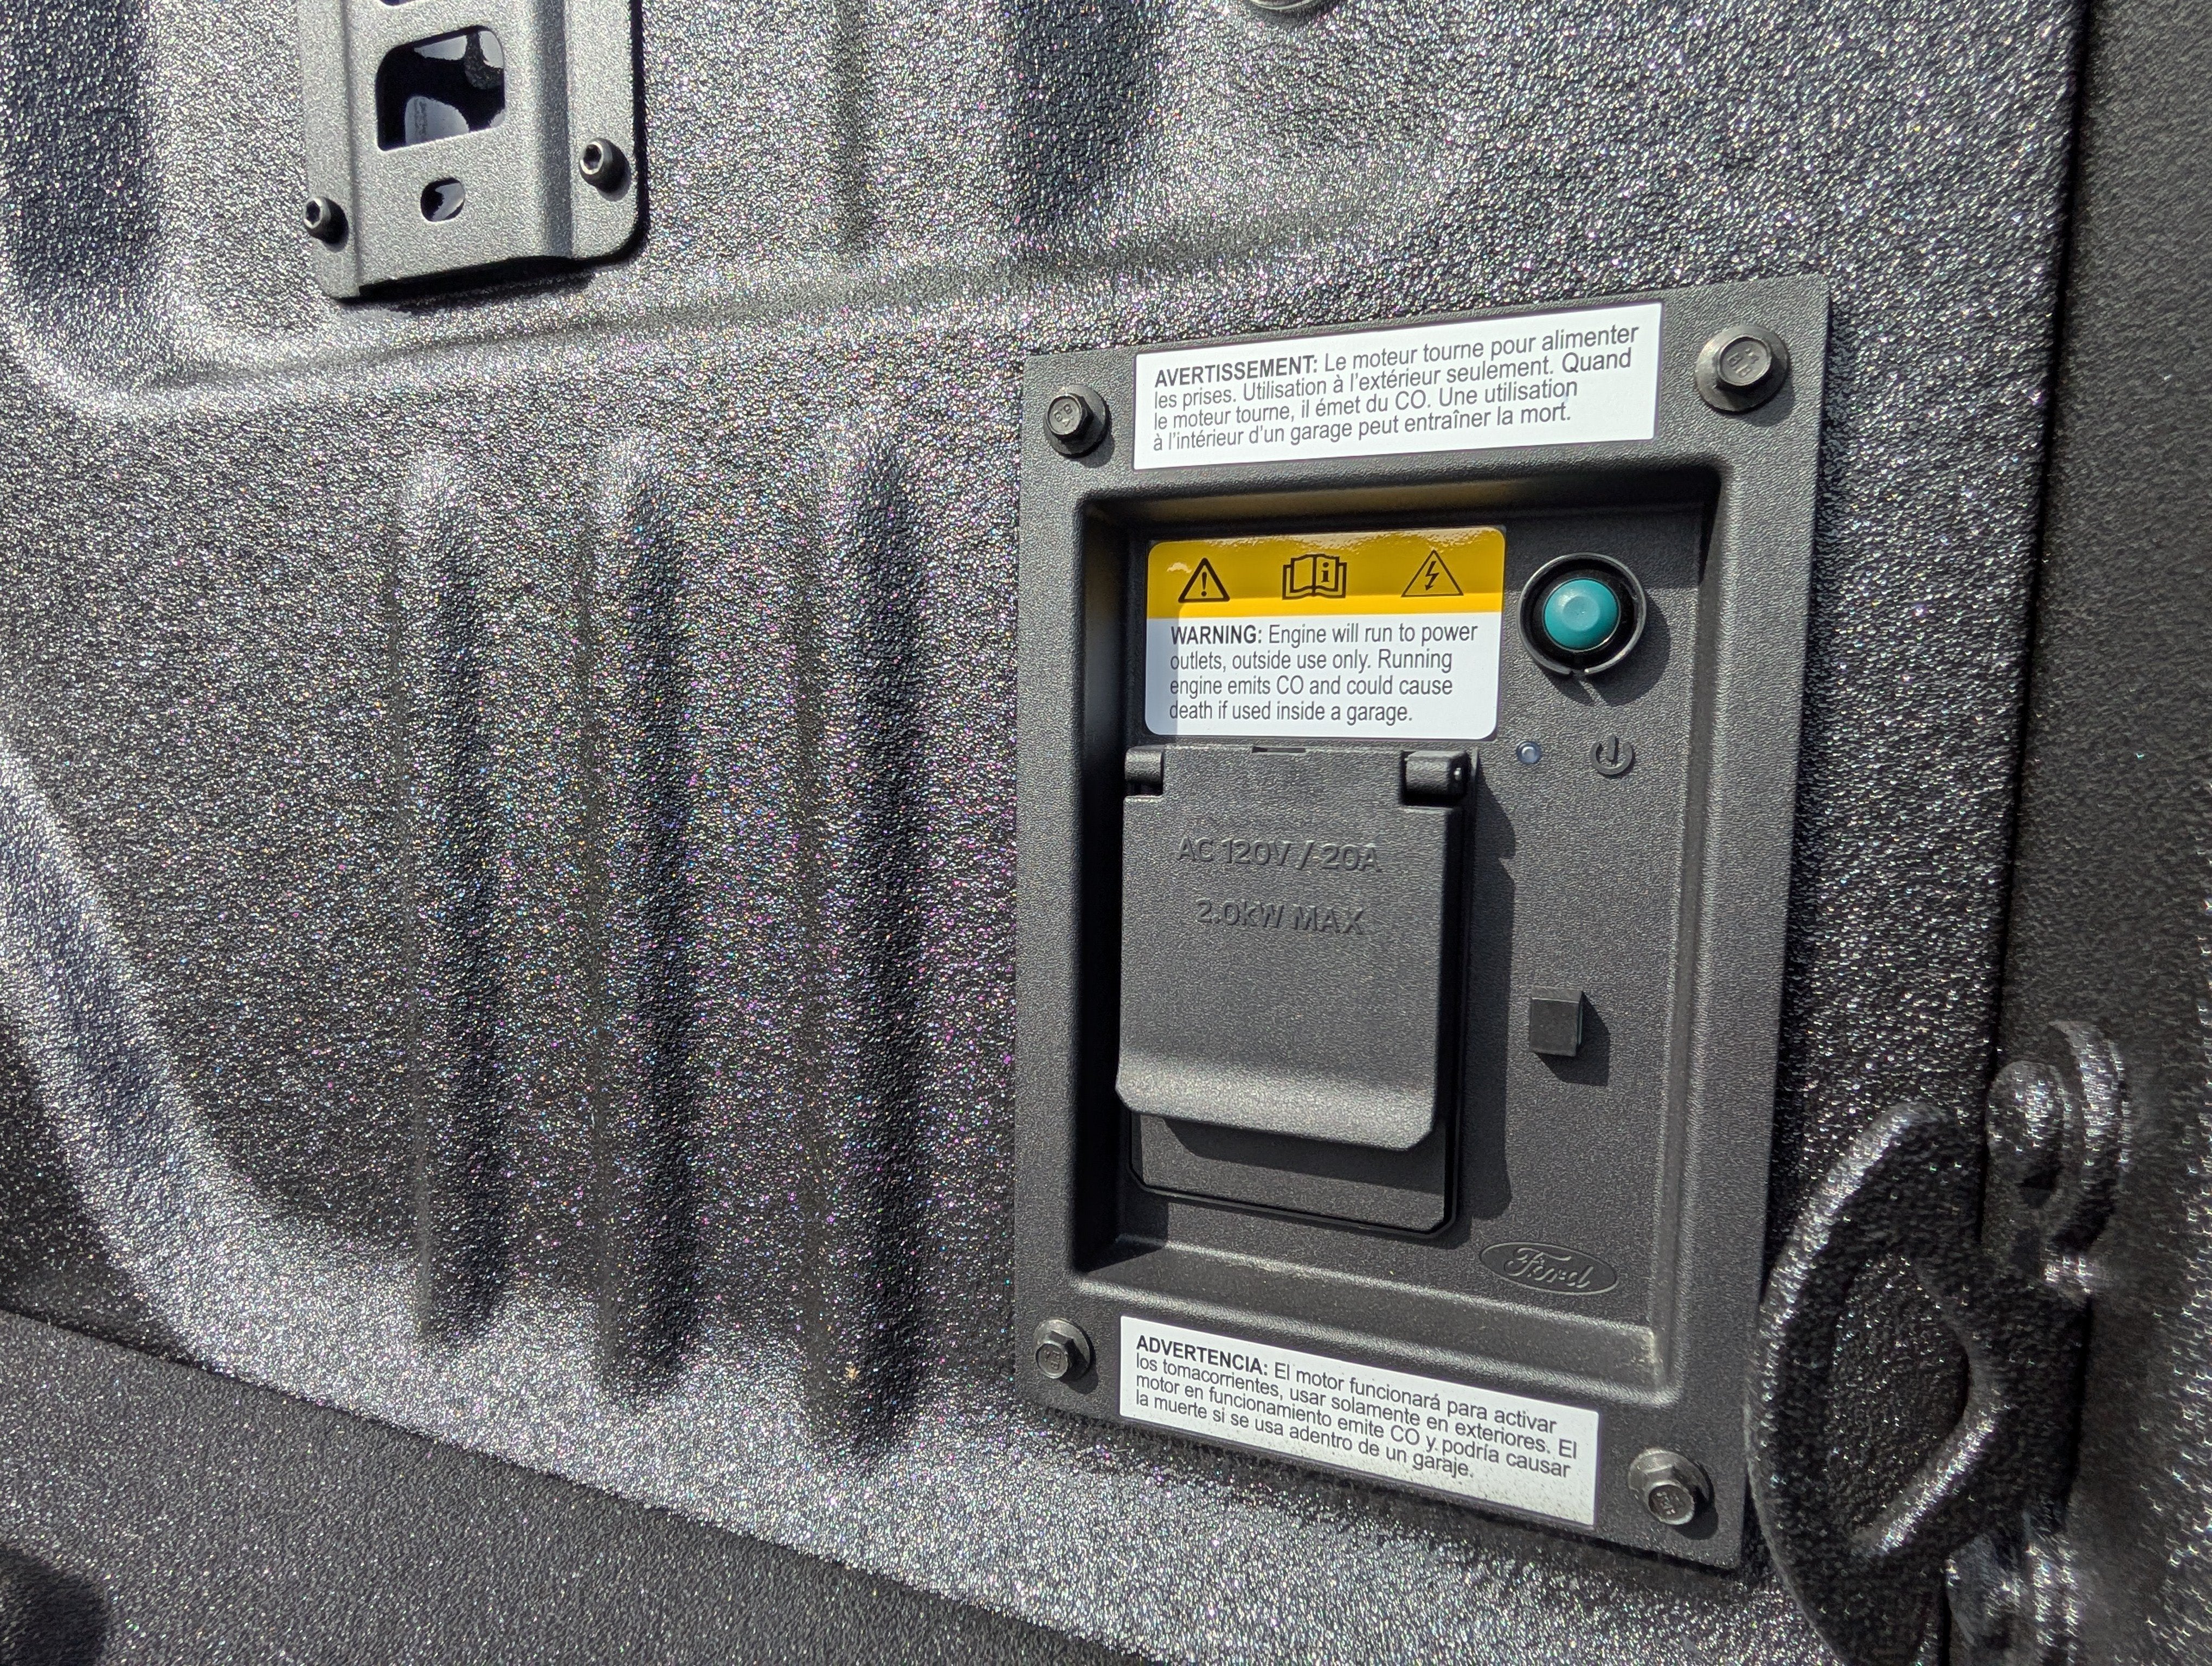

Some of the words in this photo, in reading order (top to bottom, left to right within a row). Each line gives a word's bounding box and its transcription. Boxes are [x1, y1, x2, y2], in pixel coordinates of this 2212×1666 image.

[1155, 355, 1317, 387] AVERTISSEMENT:
[1326, 354, 1346, 371] Le
[1354, 349, 1417, 371] moteur
[1423, 343, 1483, 362] tourne
[1491, 337, 1536, 361] pour
[1542, 325, 1639, 351] alimenter
[1155, 392, 1176, 408] les
[1184, 388, 1236, 411] prises.
[1244, 379, 1326, 402] Utilisation
[1333, 375, 1343, 393] à
[1351, 369, 1441, 392] l'extérieur
[1447, 356, 1553, 385] seulement.
[1562, 347, 1631, 373] Quand
[1154, 433, 1162, 451] à
[1169, 430, 1244, 450] l'intérieur
[1249, 425, 1284, 444] d'un
[1291, 423, 1352, 445] garage
[1359, 415, 1398, 440] peut
[1405, 409, 1491, 432] entraîner
[1497, 406, 1513, 425] la
[1521, 402, 1570, 423] mort.
[1155, 413, 1167, 430] le
[1174, 409, 1231, 428] moteur
[1236, 406, 1294, 423] tourne,
[1302, 400, 1309, 418] il
[1316, 396, 1360, 416] émet
[1366, 394, 1388, 412] du
[1396, 390, 1430, 409] CO.
[1439, 387, 1477, 406] Une
[1485, 380, 1577, 403] utilisation
[1171, 625, 1262, 645] WARNING:
[1269, 624, 1326, 648] Engine
[1332, 623, 1358, 642] will
[1365, 627, 1392, 642] run
[1399, 623, 1415, 642] to
[1422, 626, 1478, 646] power
[1171, 651, 1226, 672] outlets,
[1233, 650, 1290, 669] outside
[1297, 655, 1326, 669] use
[1333, 649, 1371, 674] only.
[1379, 648, 1452, 673] Running
[1171, 676, 1221, 699] engine
[1228, 676, 1270, 694] emits
[1277, 675, 1303, 694] CO
[1310, 675, 1340, 695] and
[1347, 675, 1393, 695] could
[1399, 680, 1452, 695] cause
[1170, 700, 1212, 719] death
[1219, 701, 1228, 719] if
[1233, 701, 1270, 720] used
[1277, 701, 1324, 720] inside
[1331, 706, 1340, 720] a
[1347, 706, 1412, 726] garage.
[1177, 835, 1214, 862] AC
[1221, 837, 1293, 866] 120V
[1321, 843, 1382, 872] 20A
[1292, 904, 1364, 935] MAX
[1504, 1247, 1594, 1289] Ford
[1136, 1335, 1268, 1376] ADVERTENCIA:
[1275, 1362, 1290, 1380] El
[1297, 1370, 1345, 1391] motor
[1349, 1377, 1440, 1413] funcionará
[1448, 1401, 1487, 1420] para
[1494, 1410, 1557, 1433] activar
[1136, 1353, 1158, 1372] los
[1163, 1359, 1283, 1400] tomacorrientes,
[1290, 1388, 1326, 1406] usar
[1332, 1397, 1420, 1426] solamente
[1427, 1417, 1448, 1432] en
[1455, 1422, 1550, 1454] exteriores.
[1559, 1439, 1577, 1459] El
[1136, 1375, 1180, 1393] motor
[1185, 1385, 1204, 1400] en
[1209, 1386, 1332, 1427] funcionamiento
[1338, 1418, 1384, 1438] emite
[1391, 1425, 1419, 1445] CO
[1443, 1439, 1499, 1463] podría
[1506, 1453, 1571, 1477] causar
[1136, 1389, 1148, 1406] la
[1155, 1397, 1207, 1419] muerte
[1213, 1407, 1225, 1424] si
[1231, 1413, 1249, 1428] se
[1256, 1419, 1283, 1436] usa
[1290, 1426, 1352, 1450] adentro
[1359, 1438, 1379, 1457] de
[1386, 1447, 1406, 1463] un
[1412, 1453, 1473, 1478] garaje.
